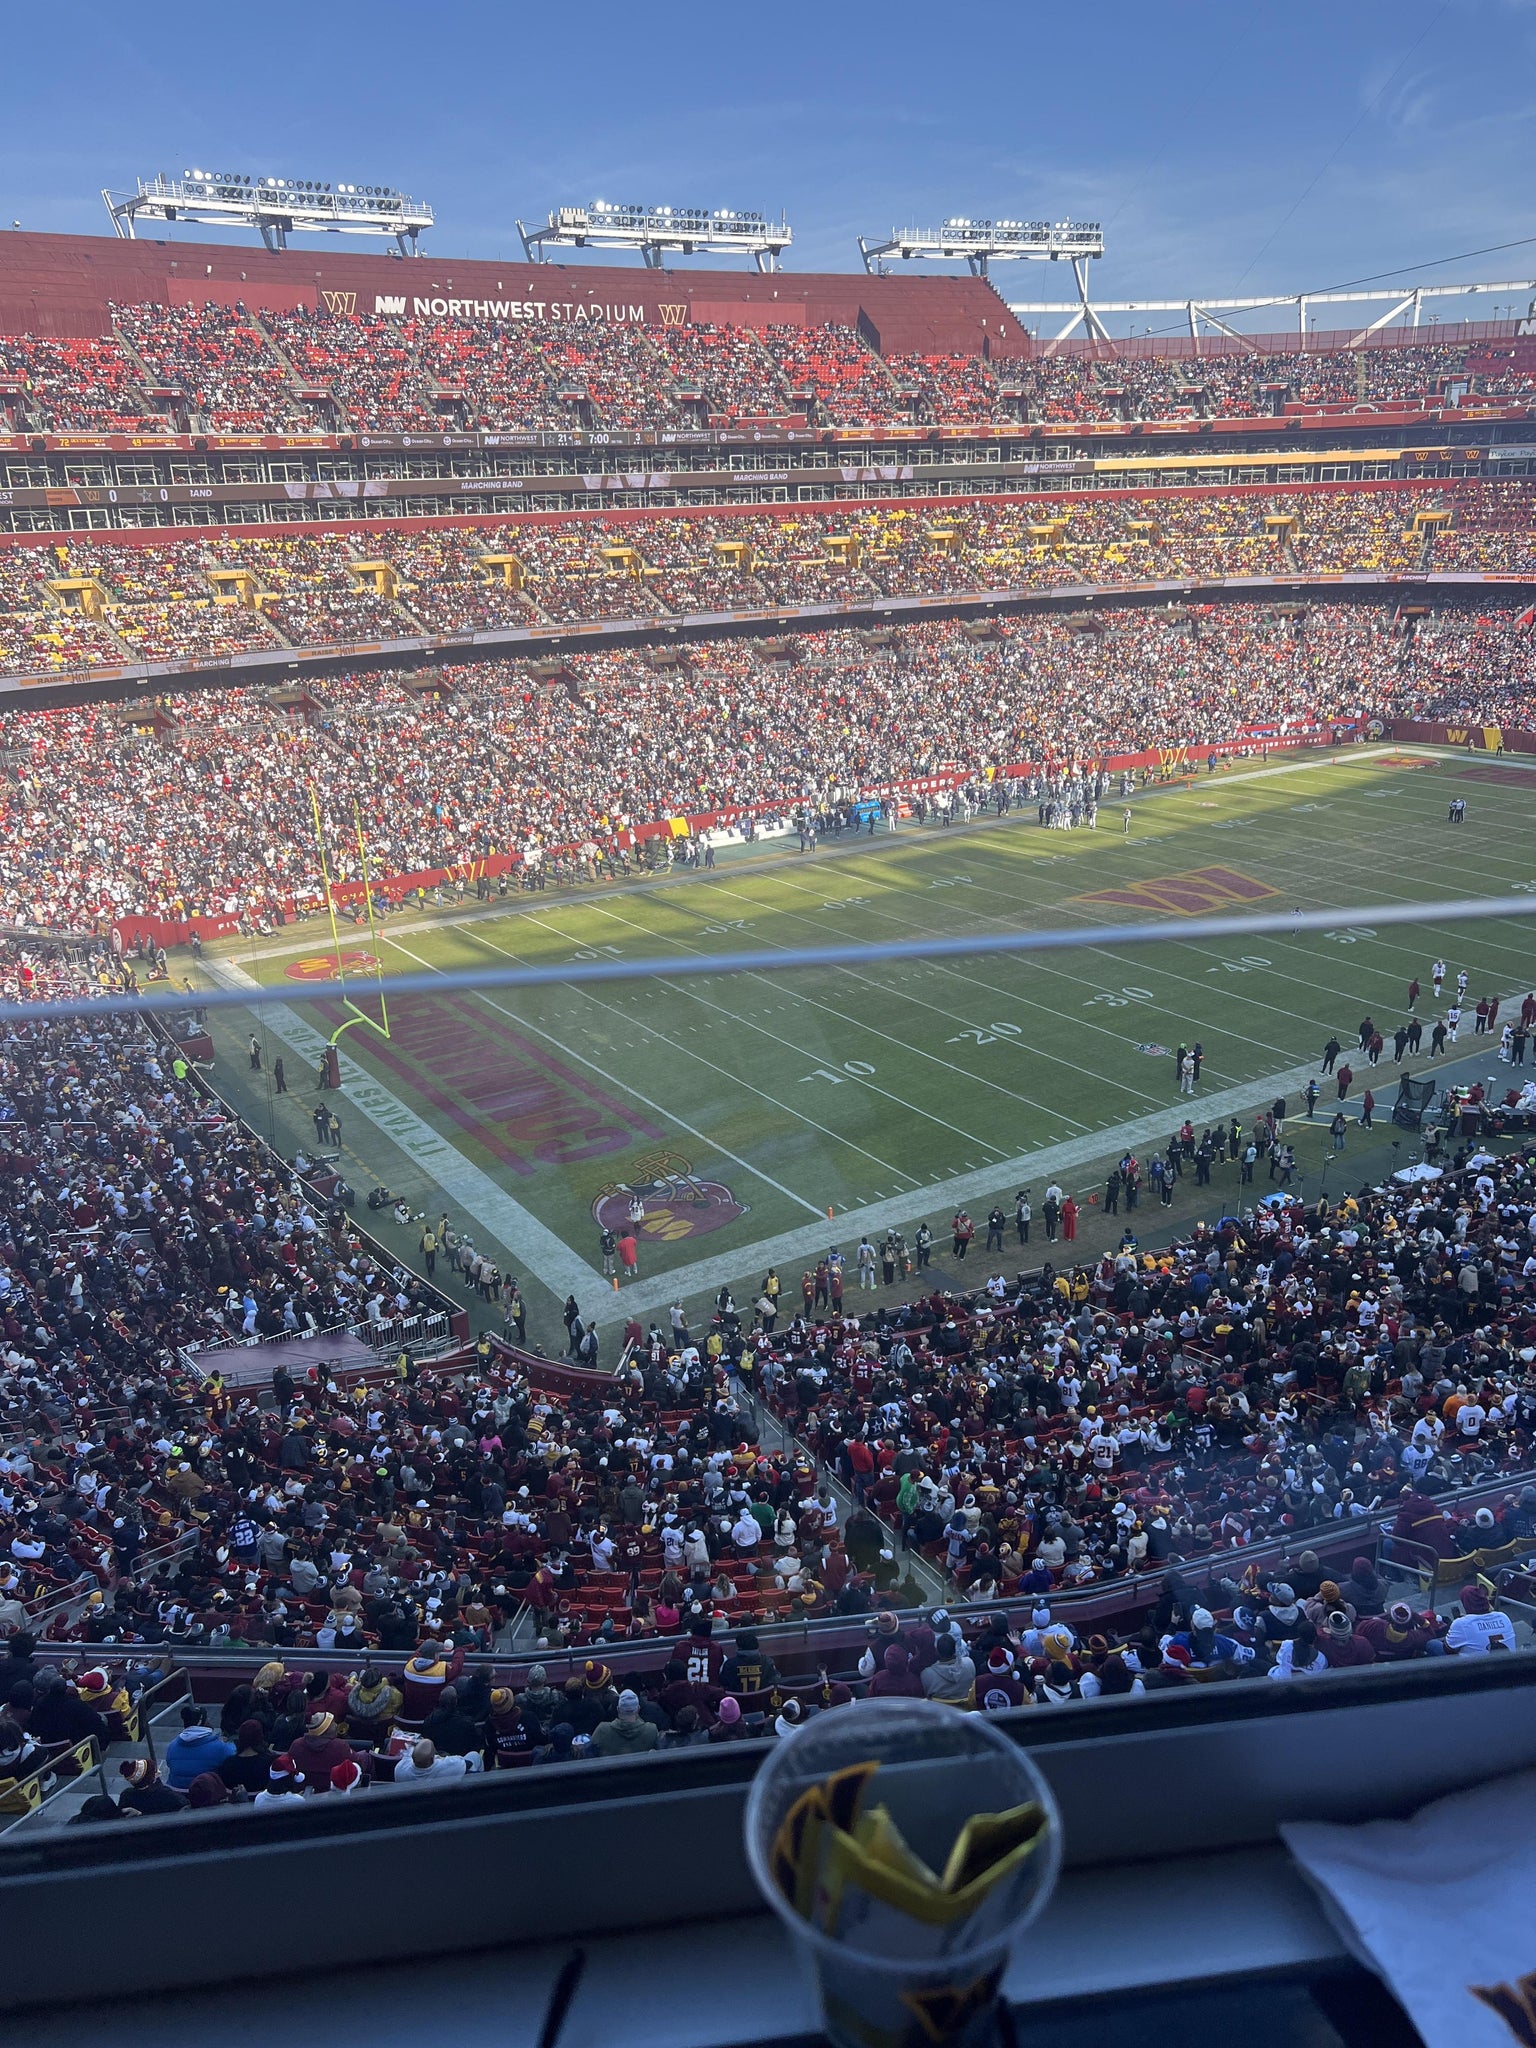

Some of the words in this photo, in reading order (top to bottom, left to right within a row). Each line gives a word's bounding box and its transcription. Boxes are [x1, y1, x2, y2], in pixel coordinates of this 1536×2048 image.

[375, 295, 406, 315] NW
[414, 298, 546, 319] NORTHWEST
[551, 302, 645, 322] STADIUM
[60, 438, 70, 447] 72
[131, 438, 142, 447] 49
[286, 438, 295, 447] 33
[558, 434, 567, 442] 21
[589, 434, 610, 444] 7:00
[1491, 449, 1516, 458] Paycor
[733, 474, 769, 482] MARCHING
[769, 473, 788, 481] BAND
[461, 481, 502, 490] MARCHING
[502, 480, 523, 489] BAND
[109, 489, 118, 502] 0
[160, 488, 168, 501] 0
[1396, 574, 1428, 582] MARCHING
[440, 635, 472, 644] MARCHING
[192, 658, 230, 669] MARCHING
[37, 676, 65, 685] RAISE
[1323, 926, 1379, 945] 50
[1219, 955, 1273, 974] 40
[1092, 986, 1155, 1008] 30
[284, 1027, 317, 1044] US
[958, 1021, 1024, 1046] 20
[813, 1059, 877, 1086] 10
[353, 1087, 423, 1137] TAKES
[406, 1139, 447, 1157] IT
[790, 1334, 801, 1345] 21
[651, 1351, 661, 1362] 91
[1062, 1386, 1073, 1398] 81
[1521, 1408, 1530, 1420] 4
[1468, 1417, 1476, 1427] 0
[1097, 1445, 1112, 1459] 21
[460, 1470, 467, 1481] 5
[235, 1529, 257, 1546] 22
[626, 1546, 641, 1557] 99
[1477, 1618, 1506, 1633] DANIELS
[691, 1646, 709, 1657] TAYLOR
[687, 1656, 710, 1683] 21
[740, 1677, 761, 1693] 17
